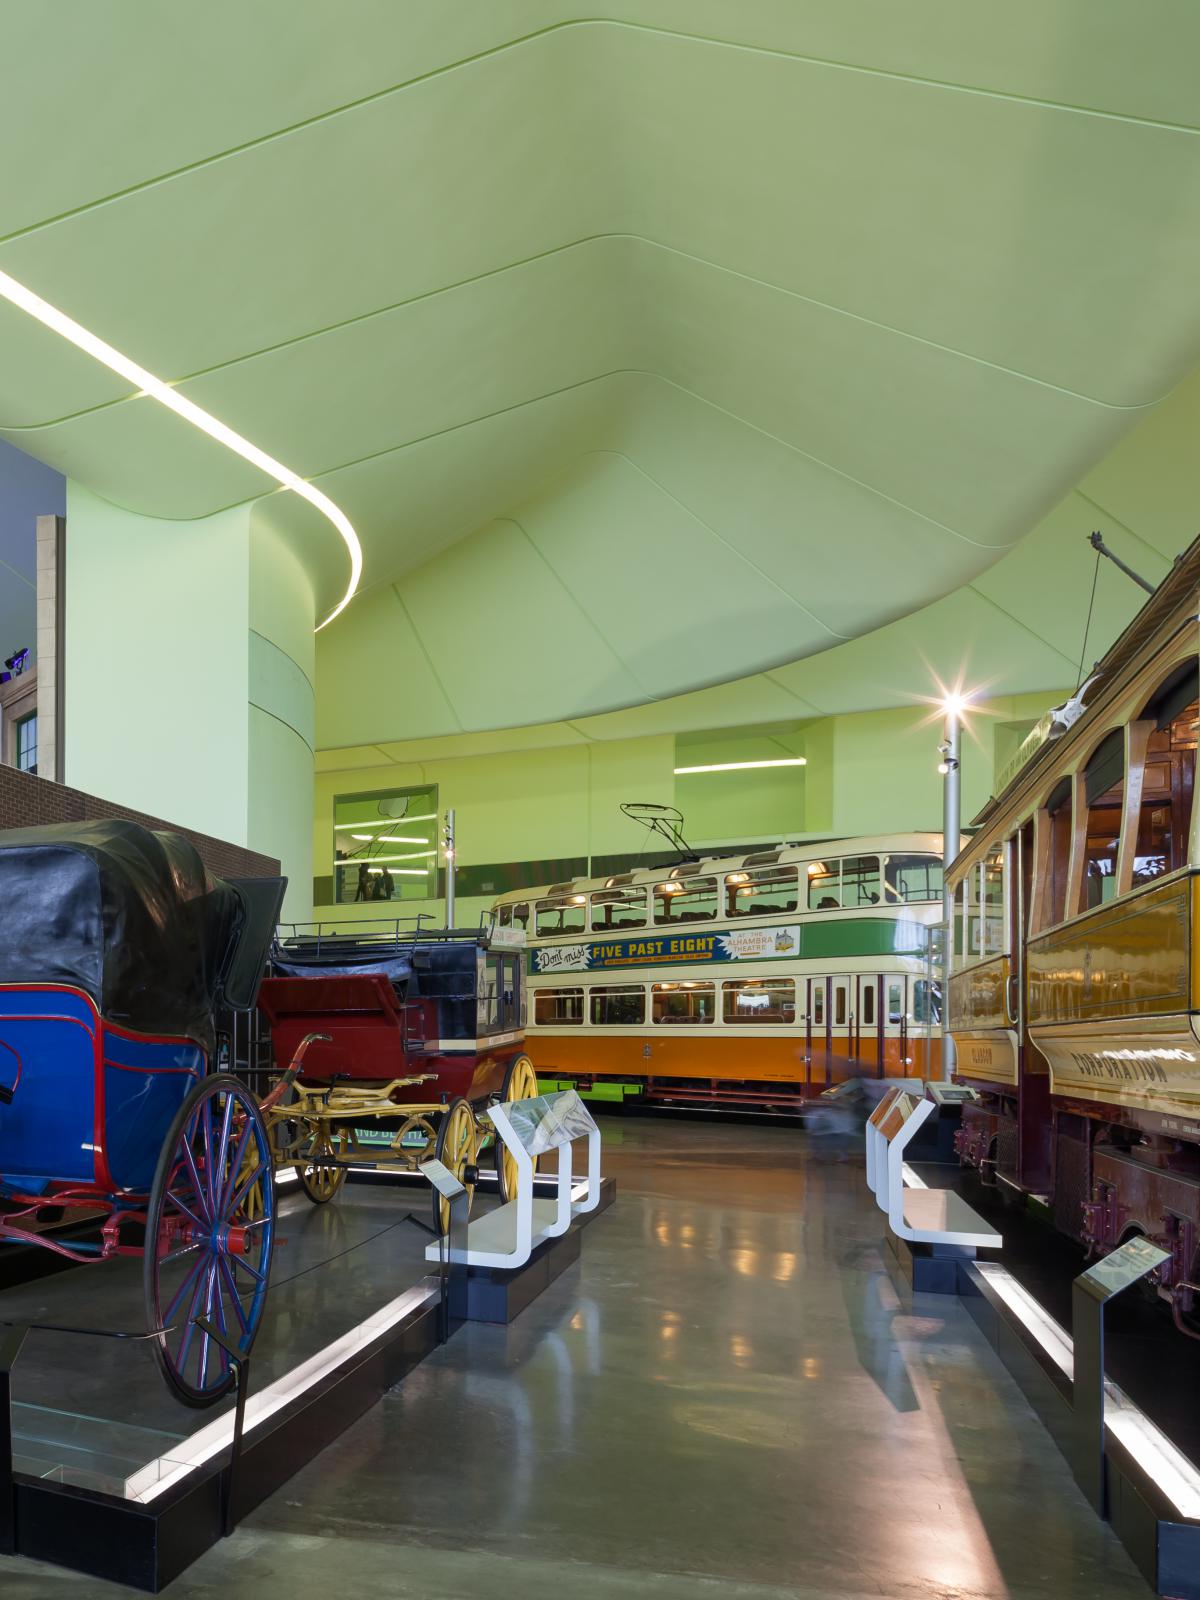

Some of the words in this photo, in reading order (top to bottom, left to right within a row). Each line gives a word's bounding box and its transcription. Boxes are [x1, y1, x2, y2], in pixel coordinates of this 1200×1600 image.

[593, 944, 622, 959] FIVE
[629, 941, 664, 956] PAST
[670, 937, 716, 953] EIGHT
[728, 936, 774, 947] ALHAMBRA
[734, 945, 767, 953] THEATRE
[1071, 1052, 1168, 1083] CORPORATION
